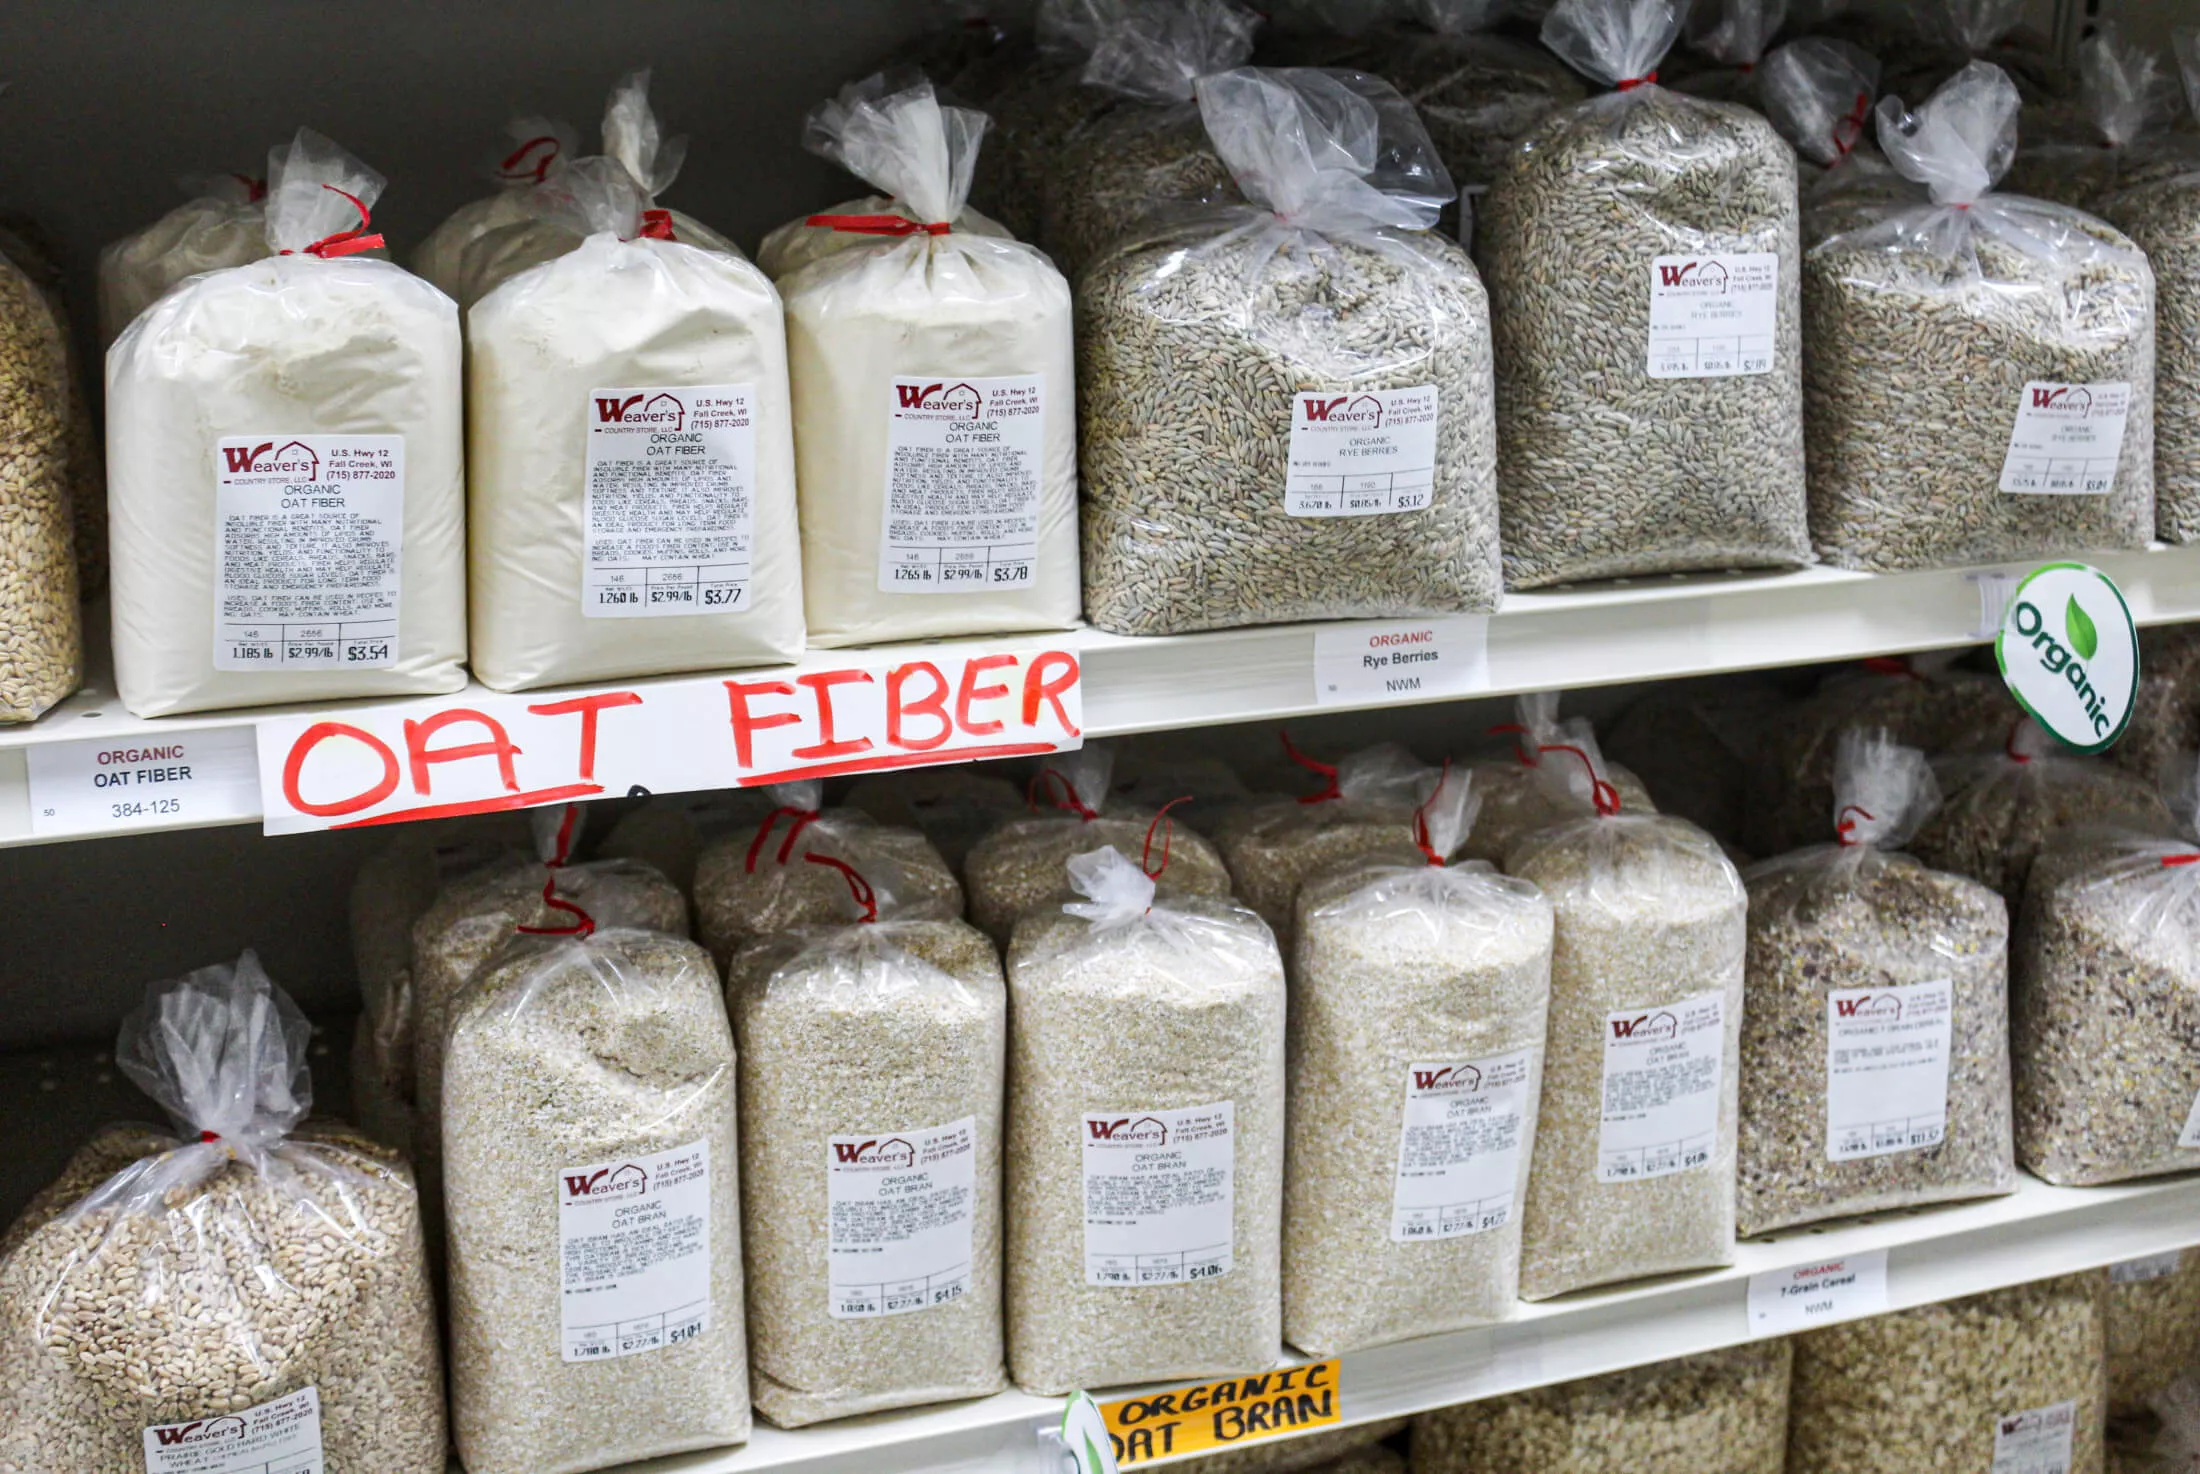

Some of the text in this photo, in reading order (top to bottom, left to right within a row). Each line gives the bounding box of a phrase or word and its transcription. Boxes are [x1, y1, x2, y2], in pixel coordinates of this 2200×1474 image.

[1660, 262, 1722, 286] Weaver's
[896, 384, 973, 409] Weaver's
[1010, 388, 1026, 397] Hwy
[2032, 387, 2086, 411] Weaver's
[595, 394, 676, 422] Weaver's
[711, 410, 735, 418] Creek,
[987, 406, 1039, 418] (715) 877-2020
[1304, 396, 1375, 422] Weaver's
[691, 418, 749, 430] (715) 877-2020
[949, 421, 998, 431] ORGANIC
[1385, 414, 1434, 427] (715) 877-2020
[650, 434, 703, 443] ORGANIC
[946, 433, 1000, 443] OAT FIBER
[1350, 436, 1390, 445] ORGANIC
[223, 442, 309, 473] Weaver's
[354, 449, 375, 458] Hwy
[647, 446, 705, 456] OAT FIBER
[1339, 446, 1398, 457] RYE BERRIES
[329, 460, 346, 468] Fall
[348, 460, 378, 469] Creek,
[326, 470, 395, 481] (715) 877-2020
[284, 485, 341, 495] ORGANIC
[281, 498, 345, 508] OAT FIBER
[1398, 494, 1424, 508] $3.12
[923, 569, 931, 580] lb
[944, 568, 983, 580] $2.99/lb
[994, 567, 1028, 582] $3.78
[600, 591, 638, 603] 1.260 lb
[651, 591, 692, 602] $2.99/lb
[705, 589, 741, 604] $3.77
[1369, 630, 1433, 648] ORGANIC
[233, 647, 273, 659] 1.185 lb
[288, 646, 333, 658] $2.99/lb
[348, 645, 388, 661] $3.54
[1363, 651, 1438, 669] Rye Berries
[2016, 601, 2110, 738] Organic
[1386, 678, 1421, 692] NWM
[282, 649, 1083, 818] OAT FIBER
[97, 745, 184, 765] ORGANIC
[94, 766, 192, 788] OAT FIBER
[44, 808, 55, 816] 50
[112, 798, 180, 818] 384-125
[1612, 1015, 1671, 1038] Weaver's
[1413, 1066, 1474, 1090] Weaver's
[1449, 1096, 1490, 1109] ORGANIC
[1087, 1119, 1160, 1140] Weaver's
[1173, 1128, 1228, 1144] (715) 877-2020
[833, 1140, 907, 1163] Weaver's
[920, 1144, 970, 1165] (715) 877-2020
[1135, 1152, 1182, 1162] ORGANIC
[674, 1158, 690, 1169] Hwy
[1132, 1161, 1187, 1172] OAT BRAN
[655, 1171, 670, 1180] Fall
[670, 1165, 693, 1177] Creek,
[881, 1172, 929, 1186] ORGANIC
[564, 1169, 640, 1196] Weaver's
[653, 1169, 704, 1192] (715) 877-2020
[878, 1182, 933, 1196] OAT BRAN
[614, 1200, 662, 1218] ORGANIC
[612, 1210, 667, 1229] OAT BRAN
[1794, 1261, 1844, 1280] ORGANIC
[1781, 1273, 1855, 1298] 7-Grain Cereal
[1118, 1364, 1330, 1426] ORGANIC
[253, 1416, 269, 1425] Fall
[271, 1408, 295, 1420] Creek,
[254, 1408, 272, 1417] U.S.
[275, 1402, 293, 1412] Hwy
[1214, 1389, 1333, 1442] BRAN
[251, 1408, 313, 1435] (715) 877-2020
[154, 1422, 238, 1446] Weaver's
[238, 1434, 267, 1449] HARD
[170, 1456, 208, 1468] WHEAT
